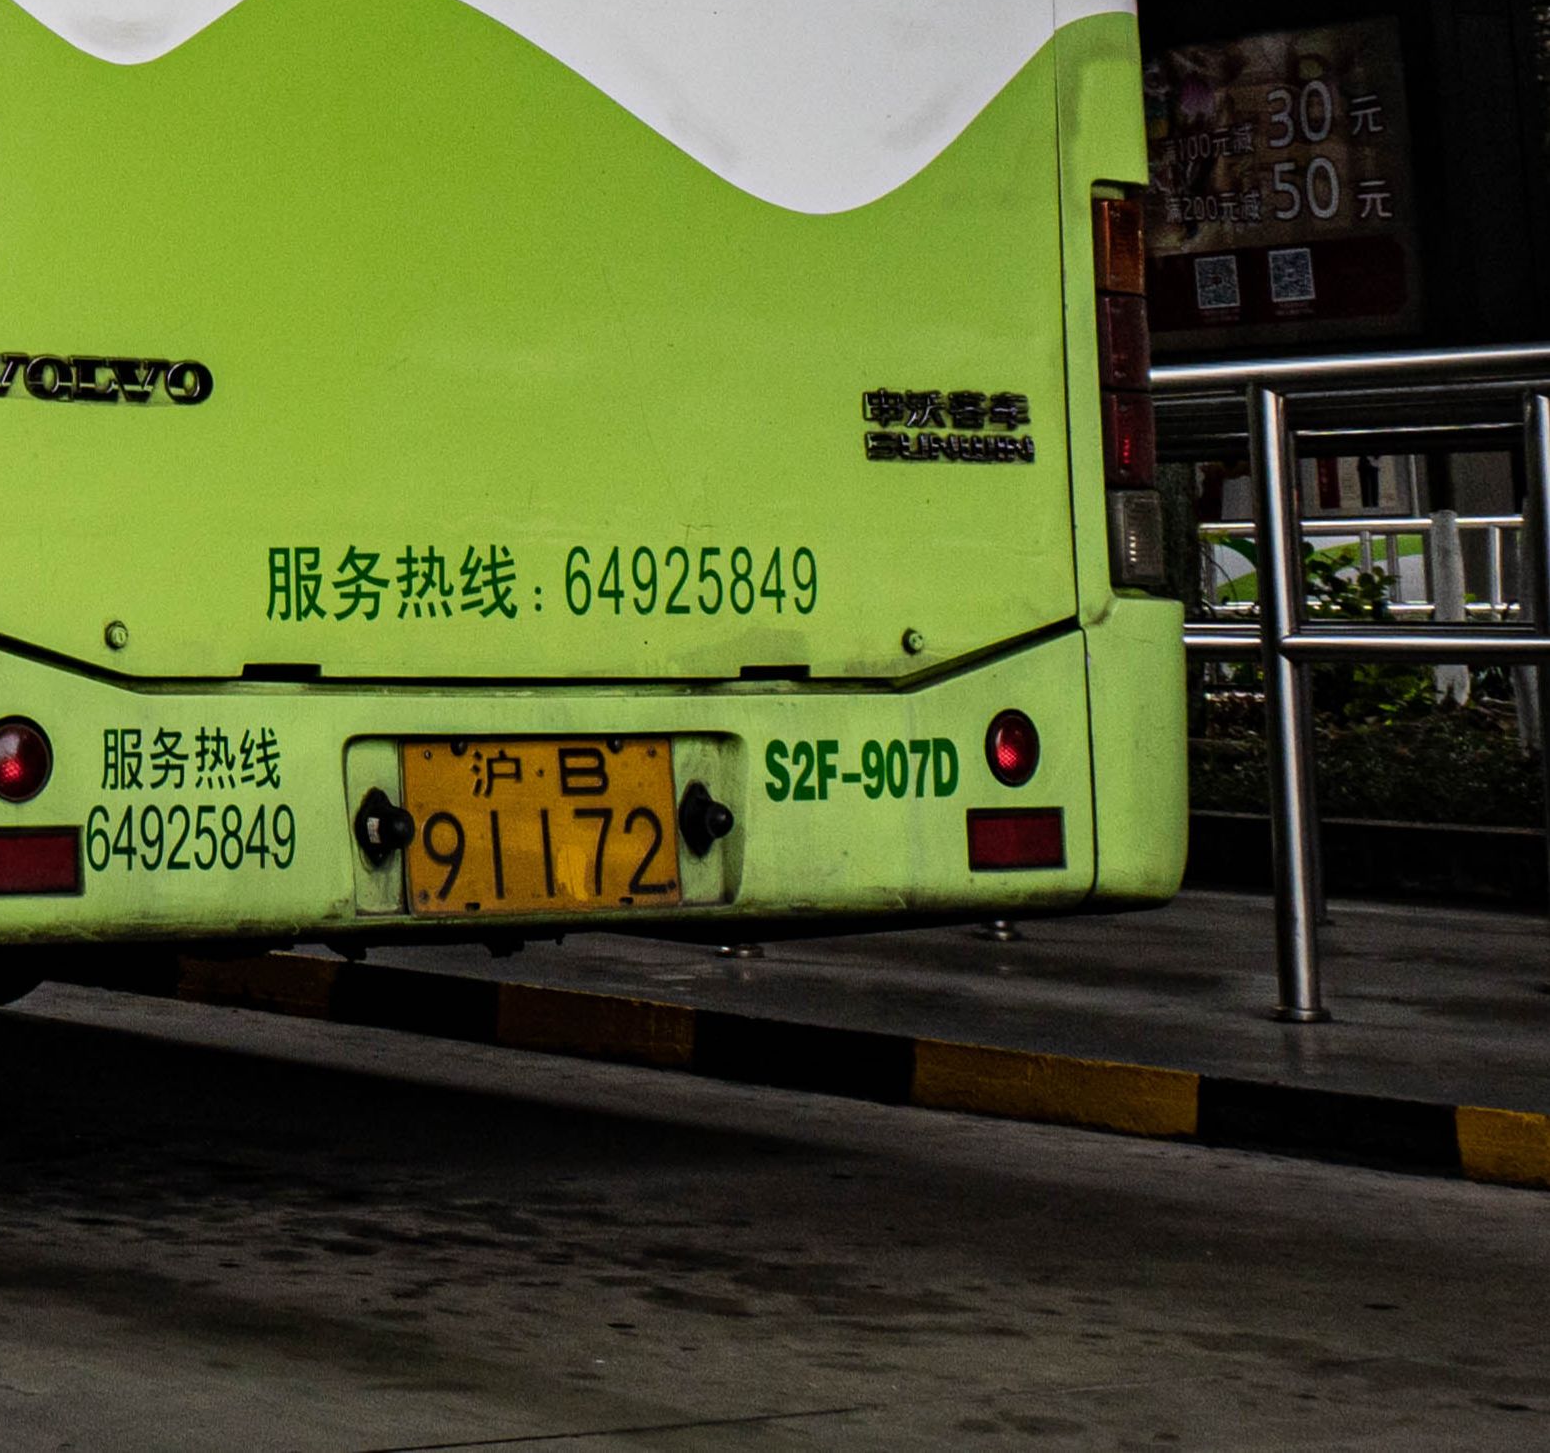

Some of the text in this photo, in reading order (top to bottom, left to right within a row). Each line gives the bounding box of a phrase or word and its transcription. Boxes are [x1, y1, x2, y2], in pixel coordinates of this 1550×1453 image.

[862, 388, 1031, 430] 申沃客车
[864, 431, 1035, 463] SUNWIN
[100, 726, 283, 793] 服务热线
[762, 738, 960, 803] S2F-907D
[84, 803, 297, 873] 64925849
[422, 806, 668, 901] 91172
